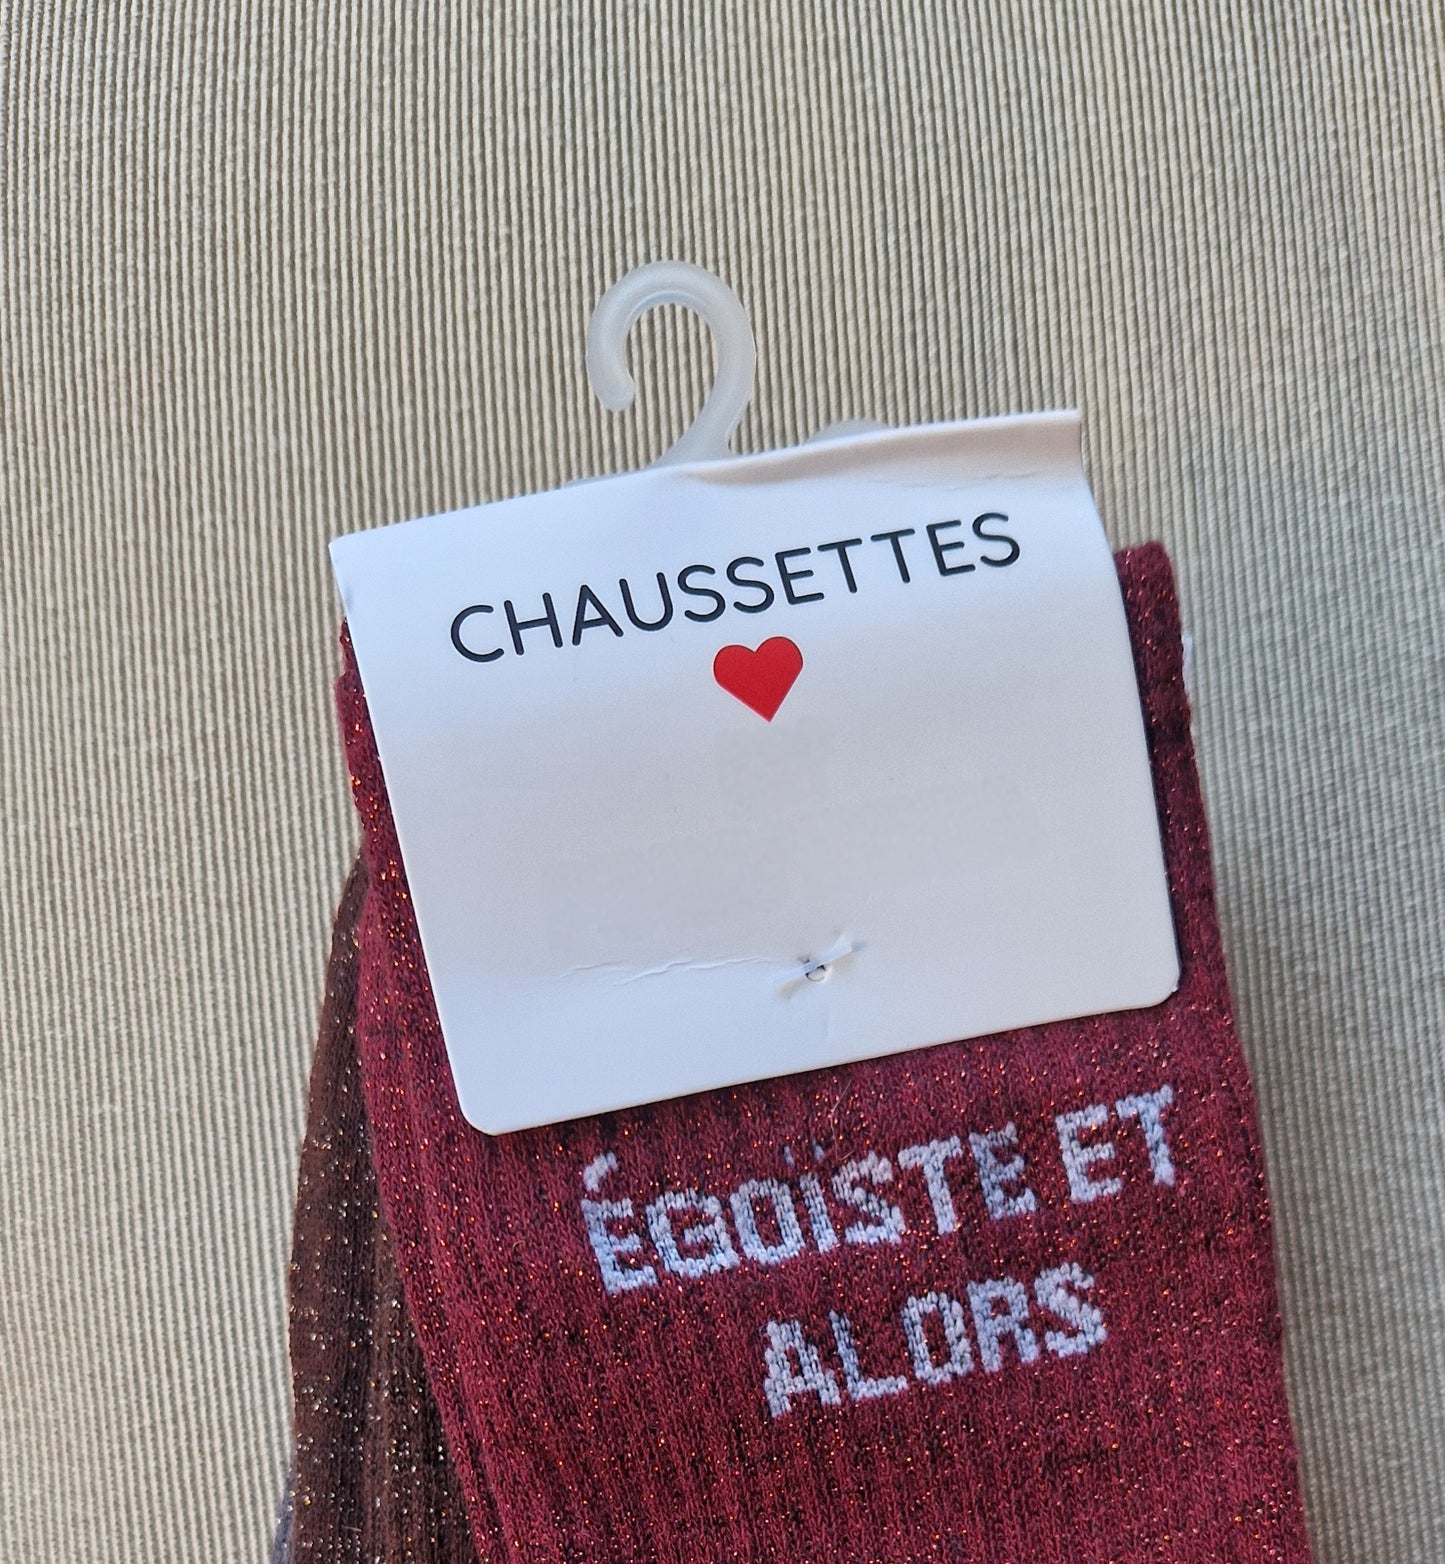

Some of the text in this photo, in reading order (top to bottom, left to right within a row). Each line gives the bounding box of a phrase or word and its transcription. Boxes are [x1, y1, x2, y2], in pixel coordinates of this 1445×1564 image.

[450, 512, 1021, 663] CHAUSSETTES
[581, 1083, 1175, 1297] ÉGOÏSTE ET
[763, 1261, 1109, 1419] ALORS
